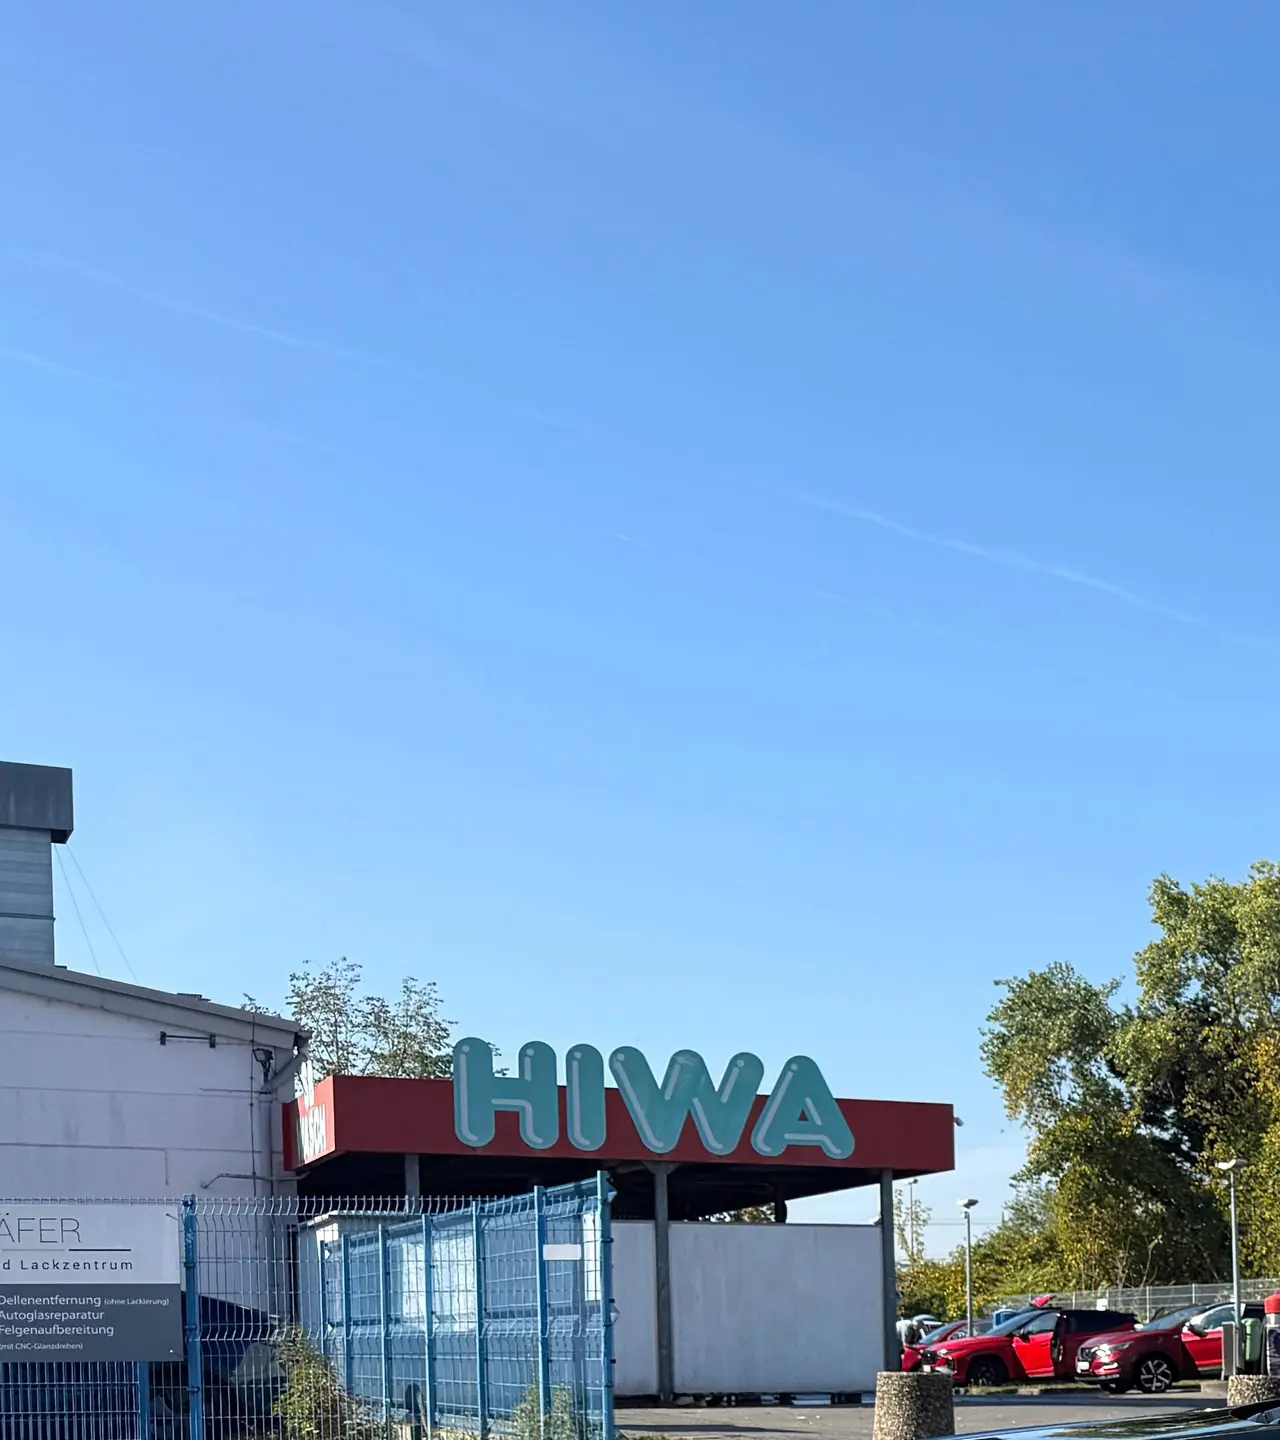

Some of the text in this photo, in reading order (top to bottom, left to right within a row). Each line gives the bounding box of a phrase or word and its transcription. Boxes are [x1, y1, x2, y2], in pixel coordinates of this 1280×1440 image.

[453, 1037, 855, 1160] HIWA
[20, 1259, 133, 1271] Lackzentrum
[0, 1294, 101, 1307] Dellenentfernung
[0, 1310, 104, 1325] Autoglasreparatur
[0, 1324, 114, 1337] Felgenaufbereitung
